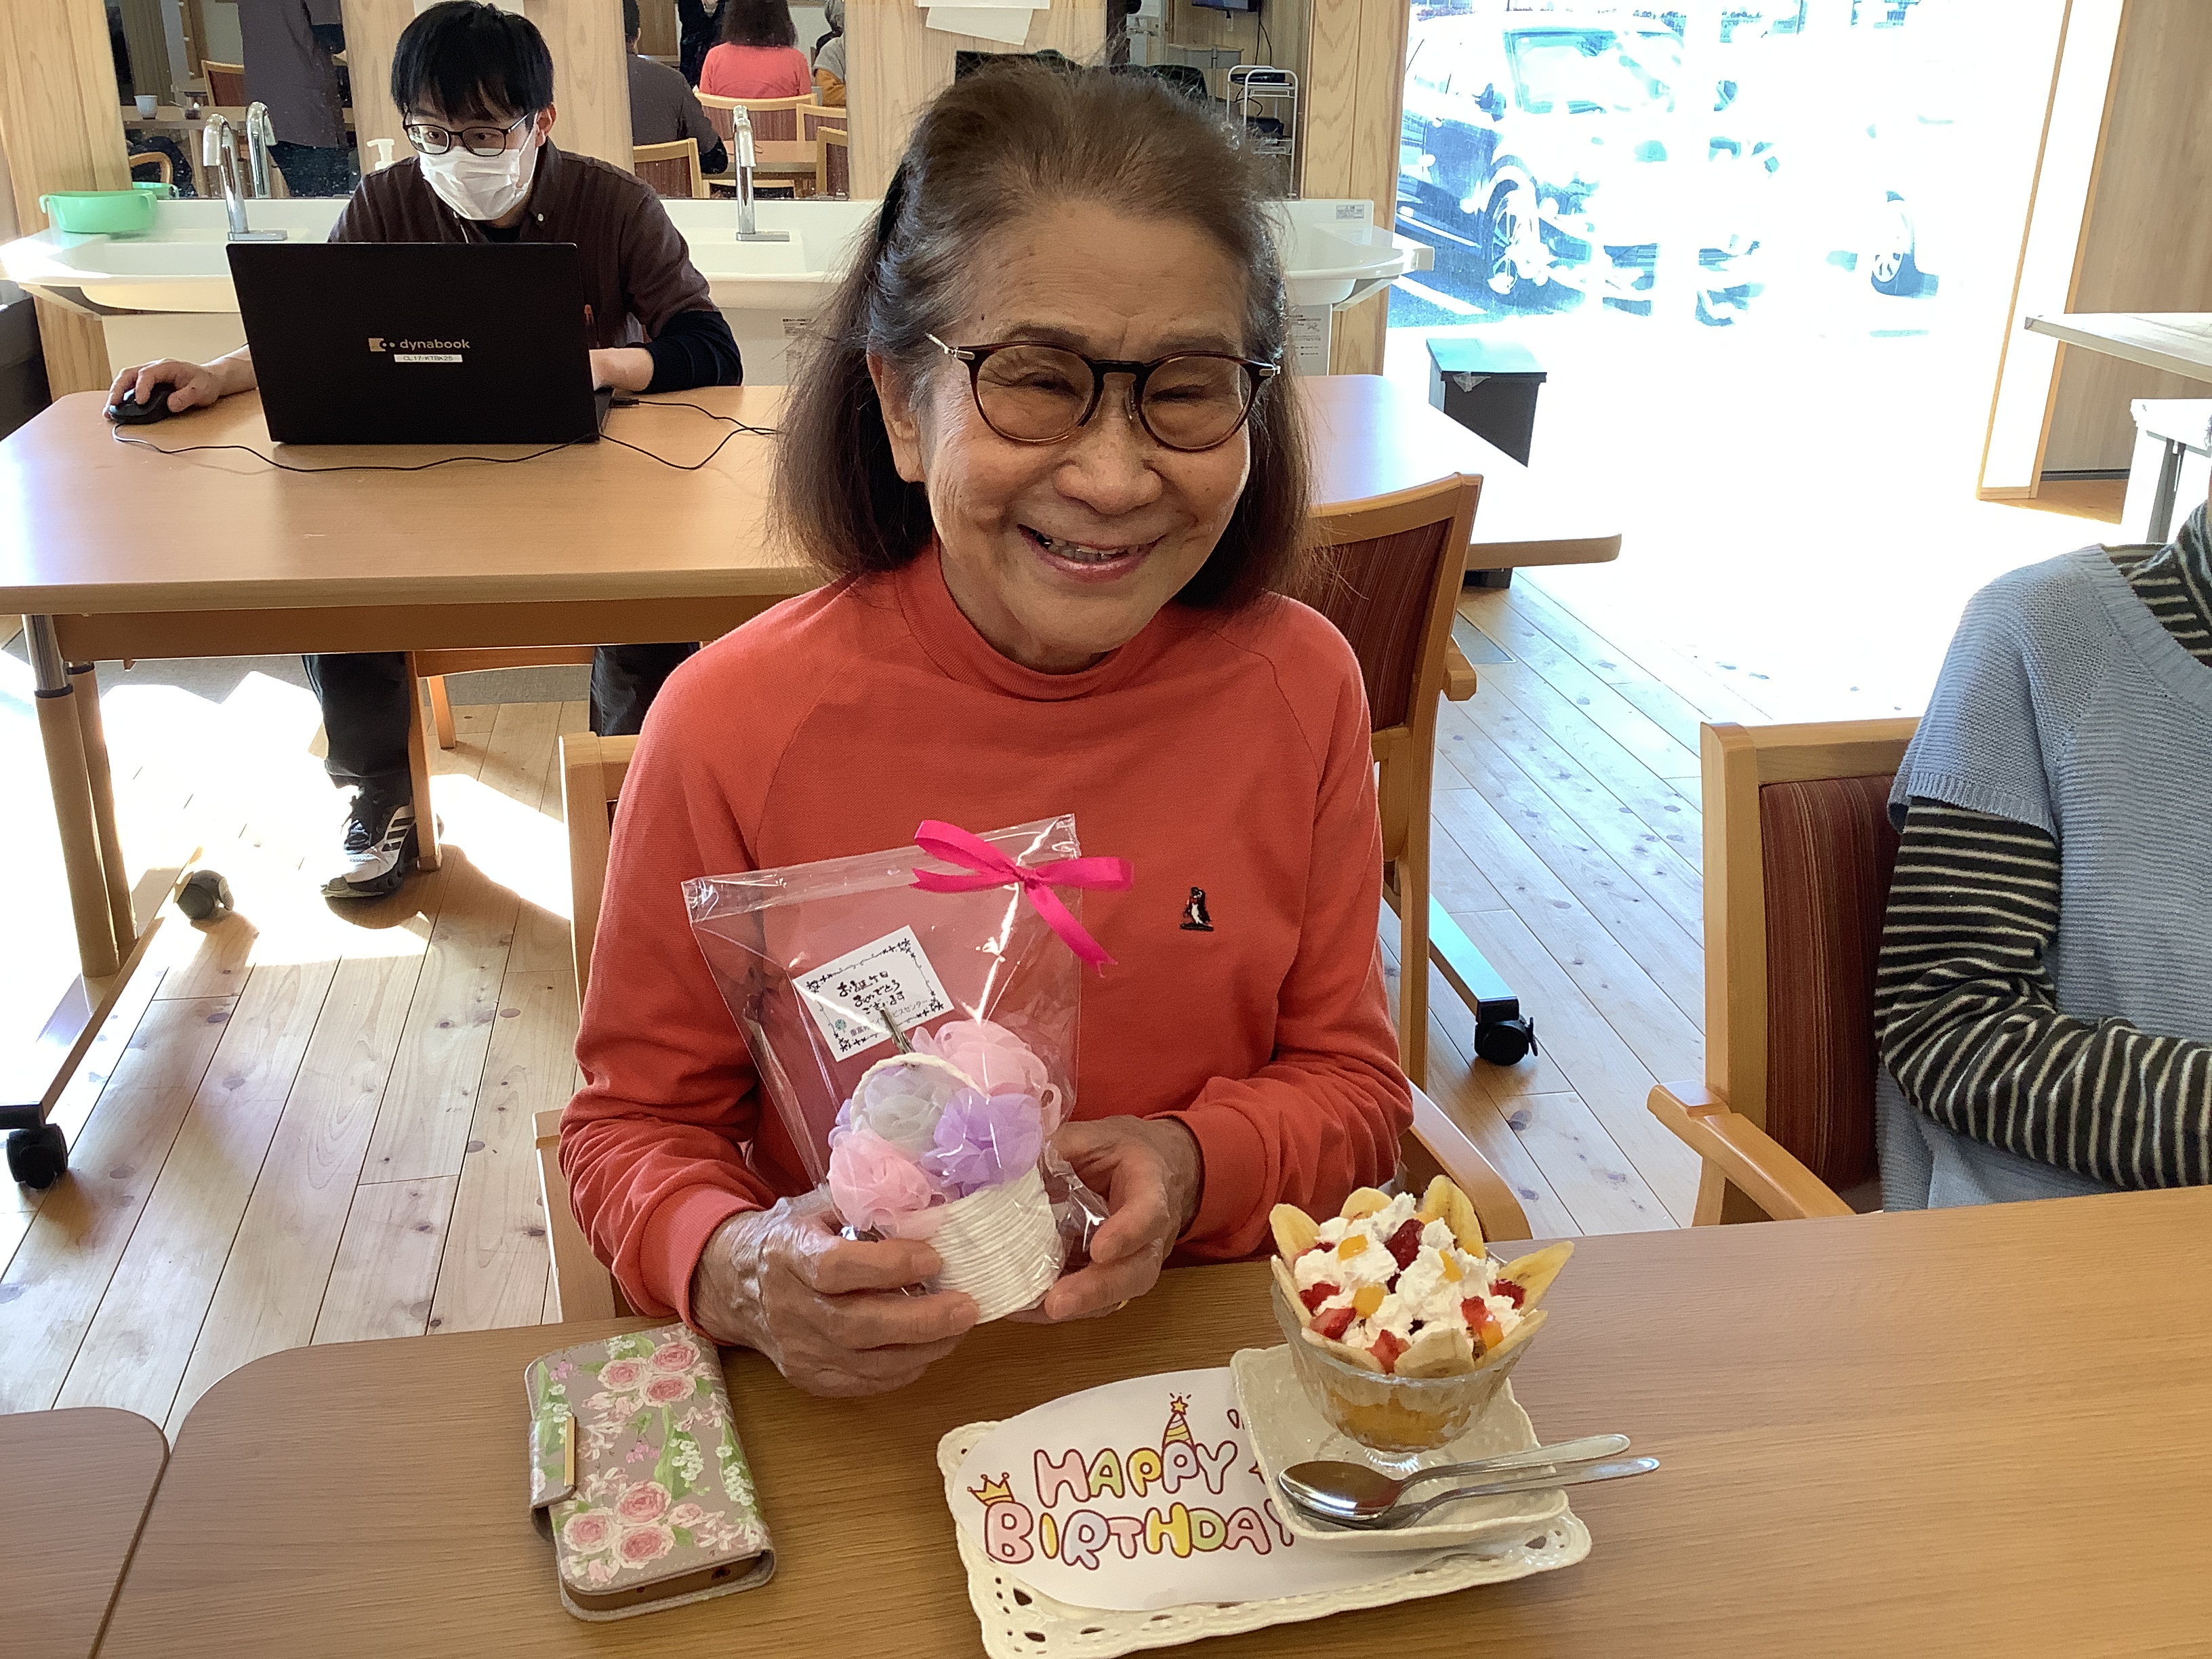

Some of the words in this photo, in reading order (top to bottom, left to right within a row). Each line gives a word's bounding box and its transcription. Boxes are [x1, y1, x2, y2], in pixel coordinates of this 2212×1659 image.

[400, 339, 470, 351] dynabook
[836, 970, 888, 997] お誕生日
[853, 979, 901, 1007] おめでとう
[862, 991, 905, 1015] ございます
[1034, 1439, 1238, 1509] HAPPY
